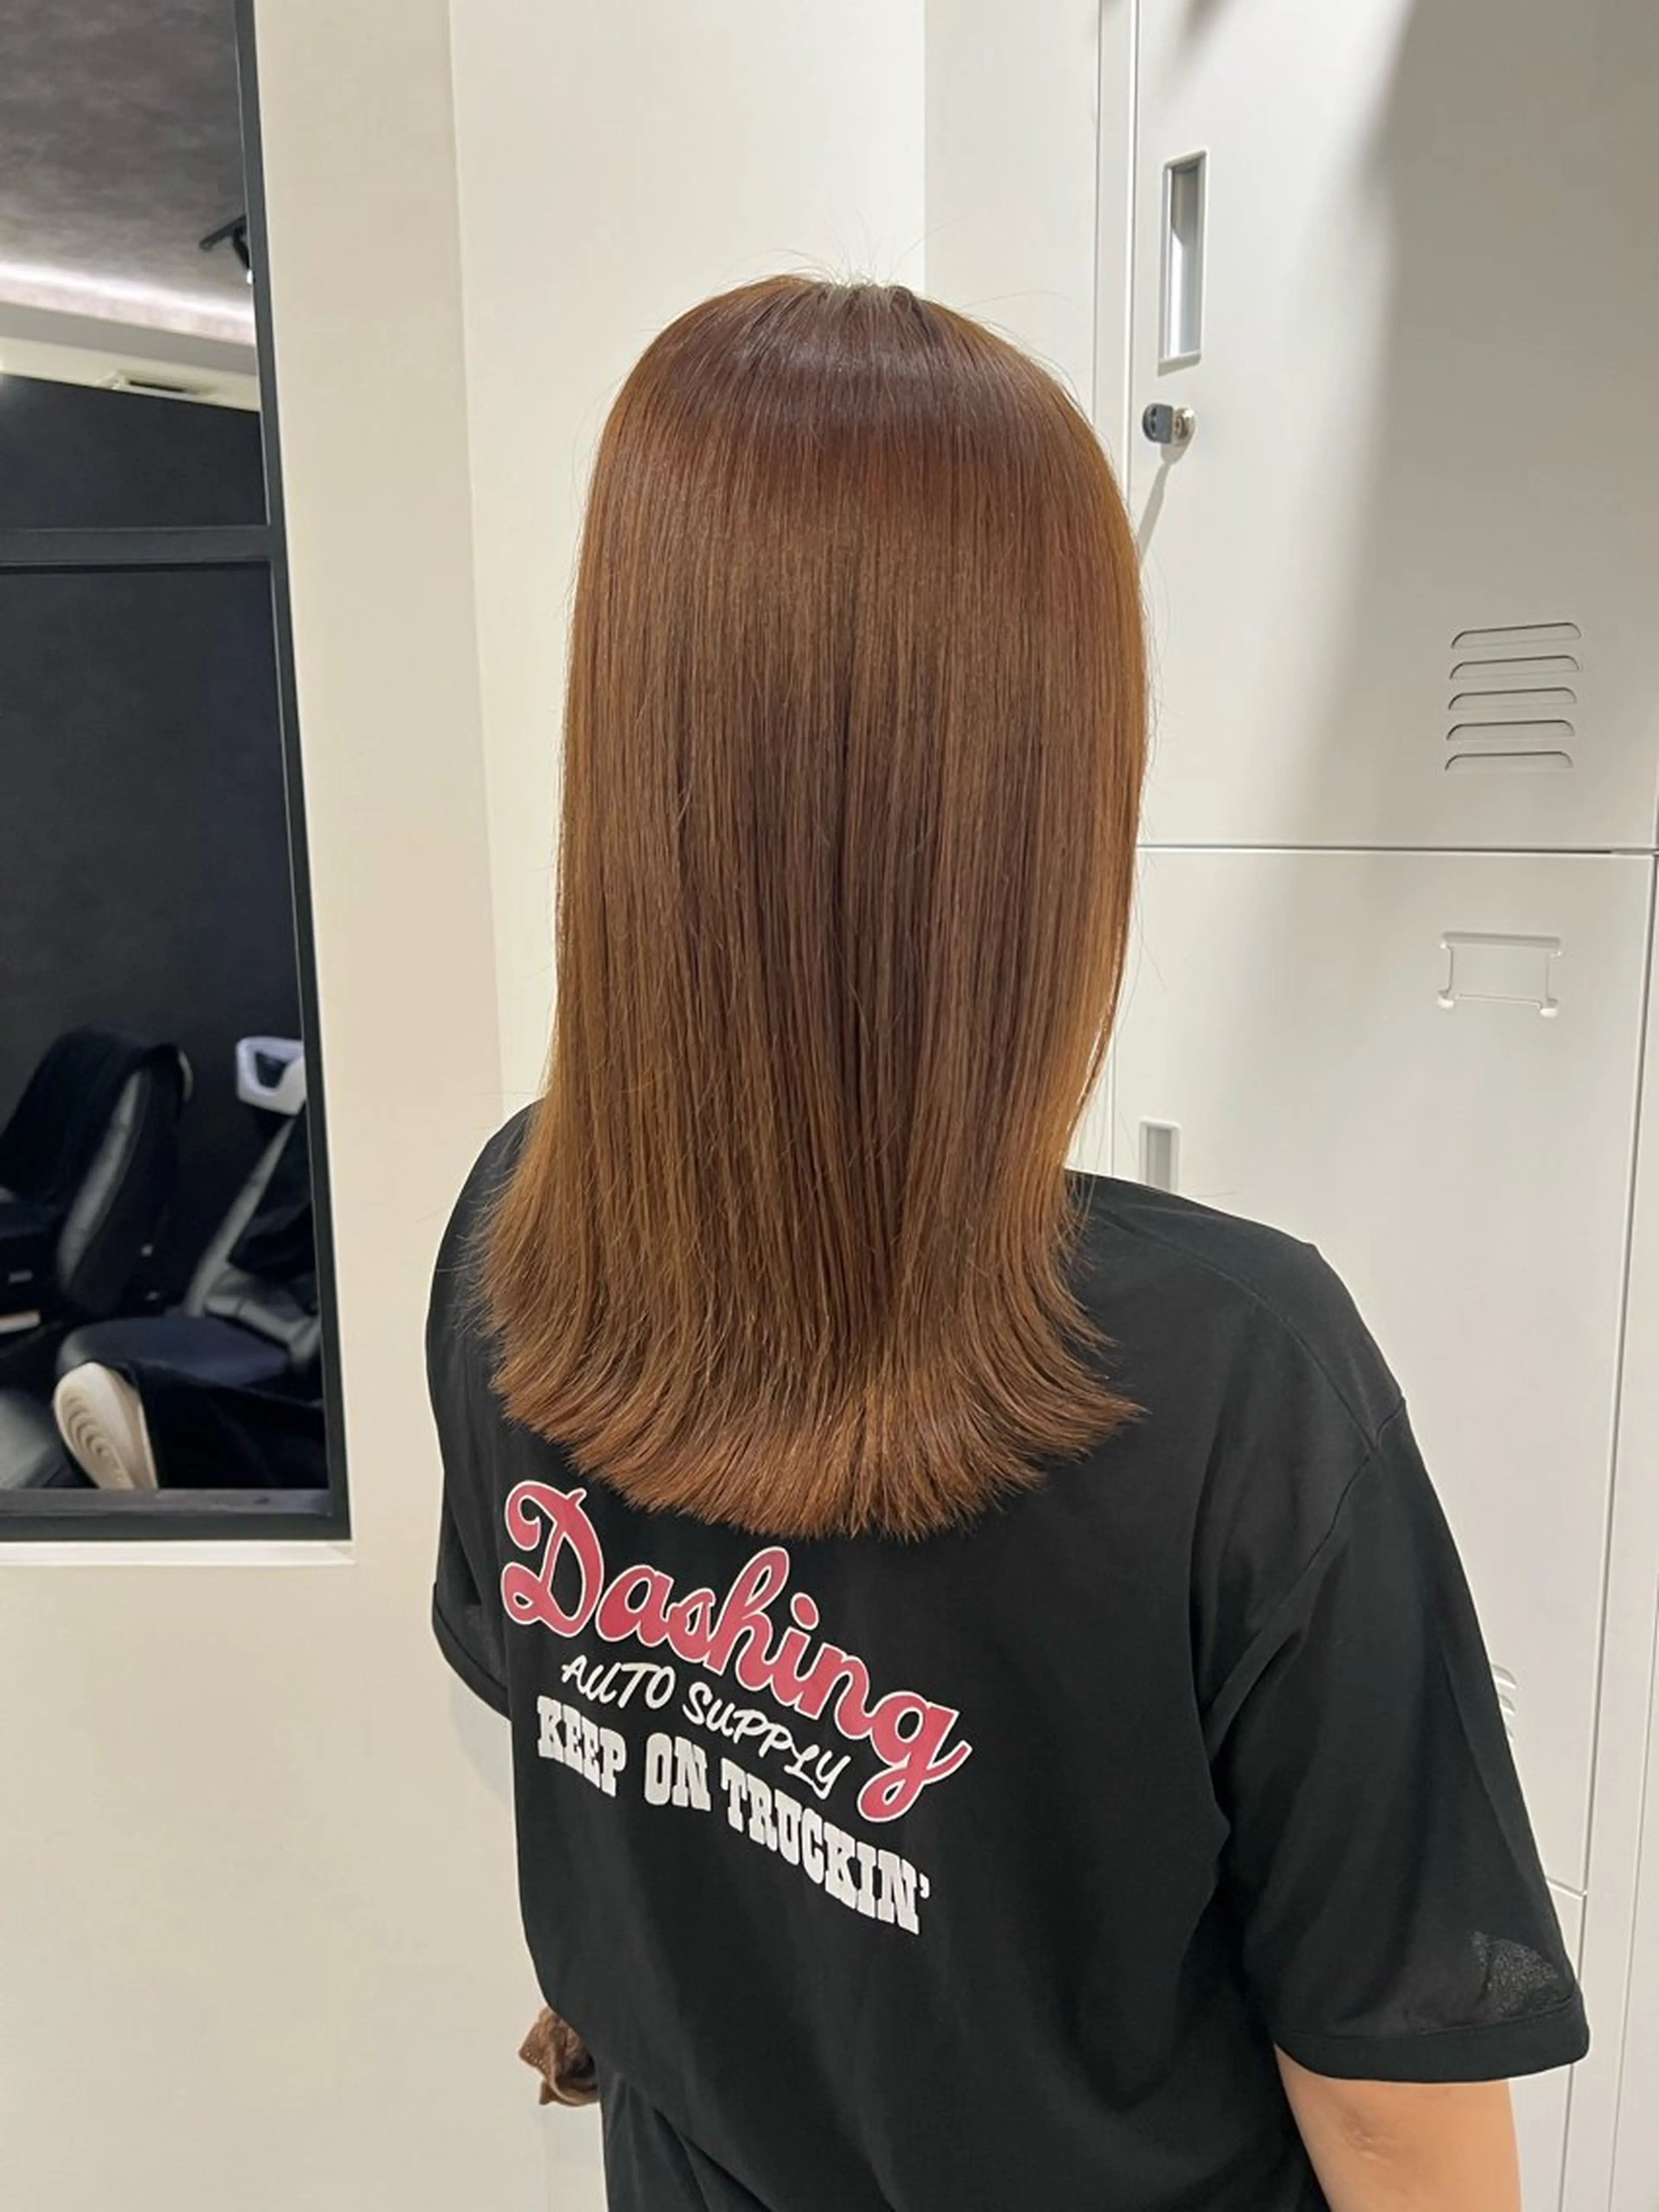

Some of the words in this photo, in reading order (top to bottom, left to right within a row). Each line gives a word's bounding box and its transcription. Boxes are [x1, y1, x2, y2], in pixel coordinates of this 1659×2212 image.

[501, 1480, 973, 1823] Dashing
[561, 1654, 676, 1709] AUTO
[682, 1681, 851, 1799] SUPPLY
[537, 1695, 626, 1797] KEEP
[644, 1732, 711, 1812] ON
[721, 1758, 930, 1935] TRUCKIN'
